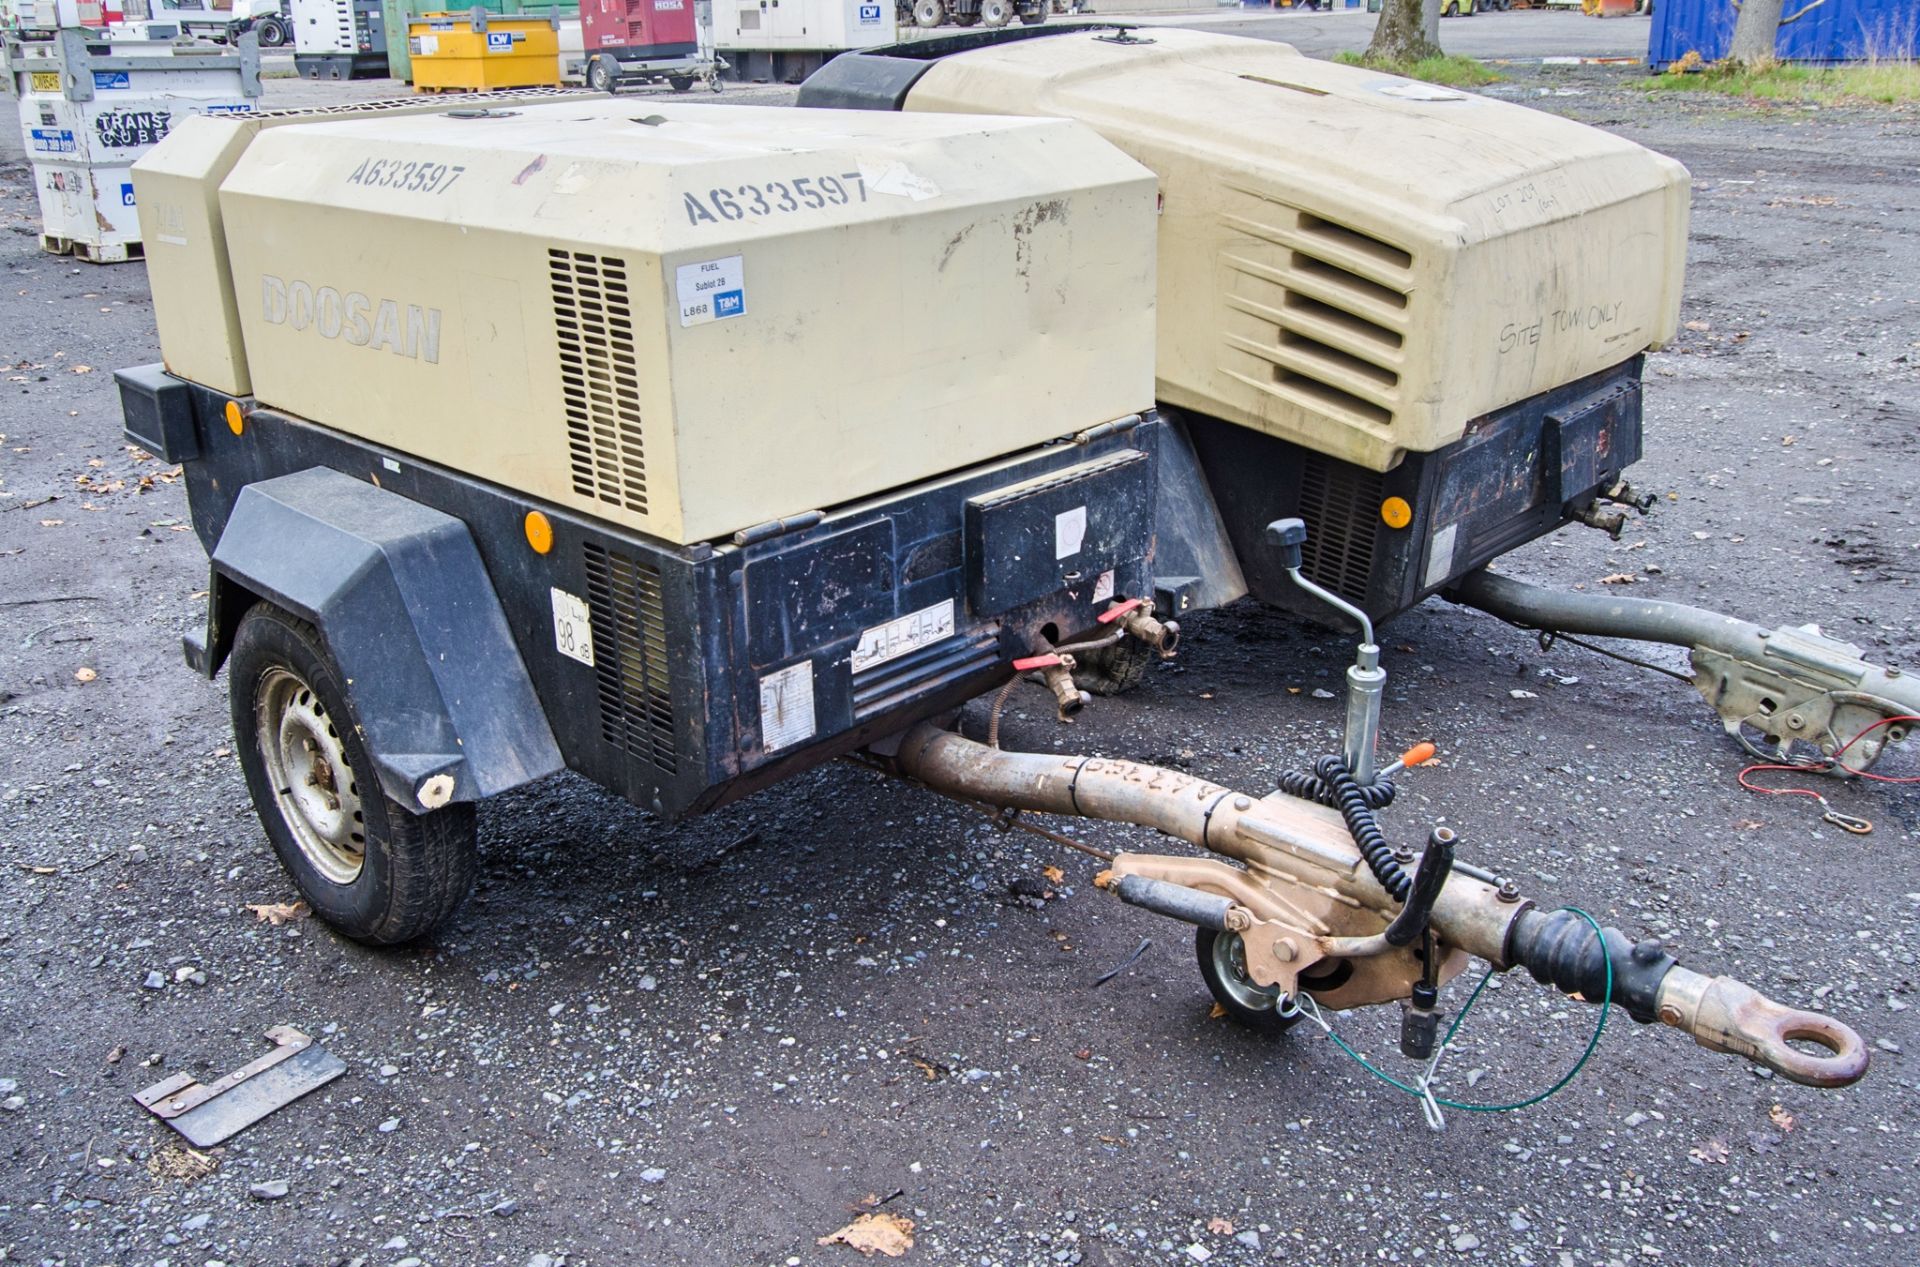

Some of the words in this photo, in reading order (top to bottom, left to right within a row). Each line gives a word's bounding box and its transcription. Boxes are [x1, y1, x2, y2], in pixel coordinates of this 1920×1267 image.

[490, 33, 508, 45] CW
[99, 114, 163, 131] TRANS
[102, 130, 165, 144] CUBE
[346, 157, 466, 195] A633597
[683, 172, 868, 226] A633597
[1489, 193, 1512, 214] LOT
[701, 262, 720, 273] FUEL
[695, 279, 716, 291] Sublot
[718, 296, 739, 310] T&M
[262, 274, 442, 364] DOOSAN
[1551, 308, 1581, 334] TOW
[1588, 301, 1623, 330] ONLY
[558, 618, 575, 652] 98
